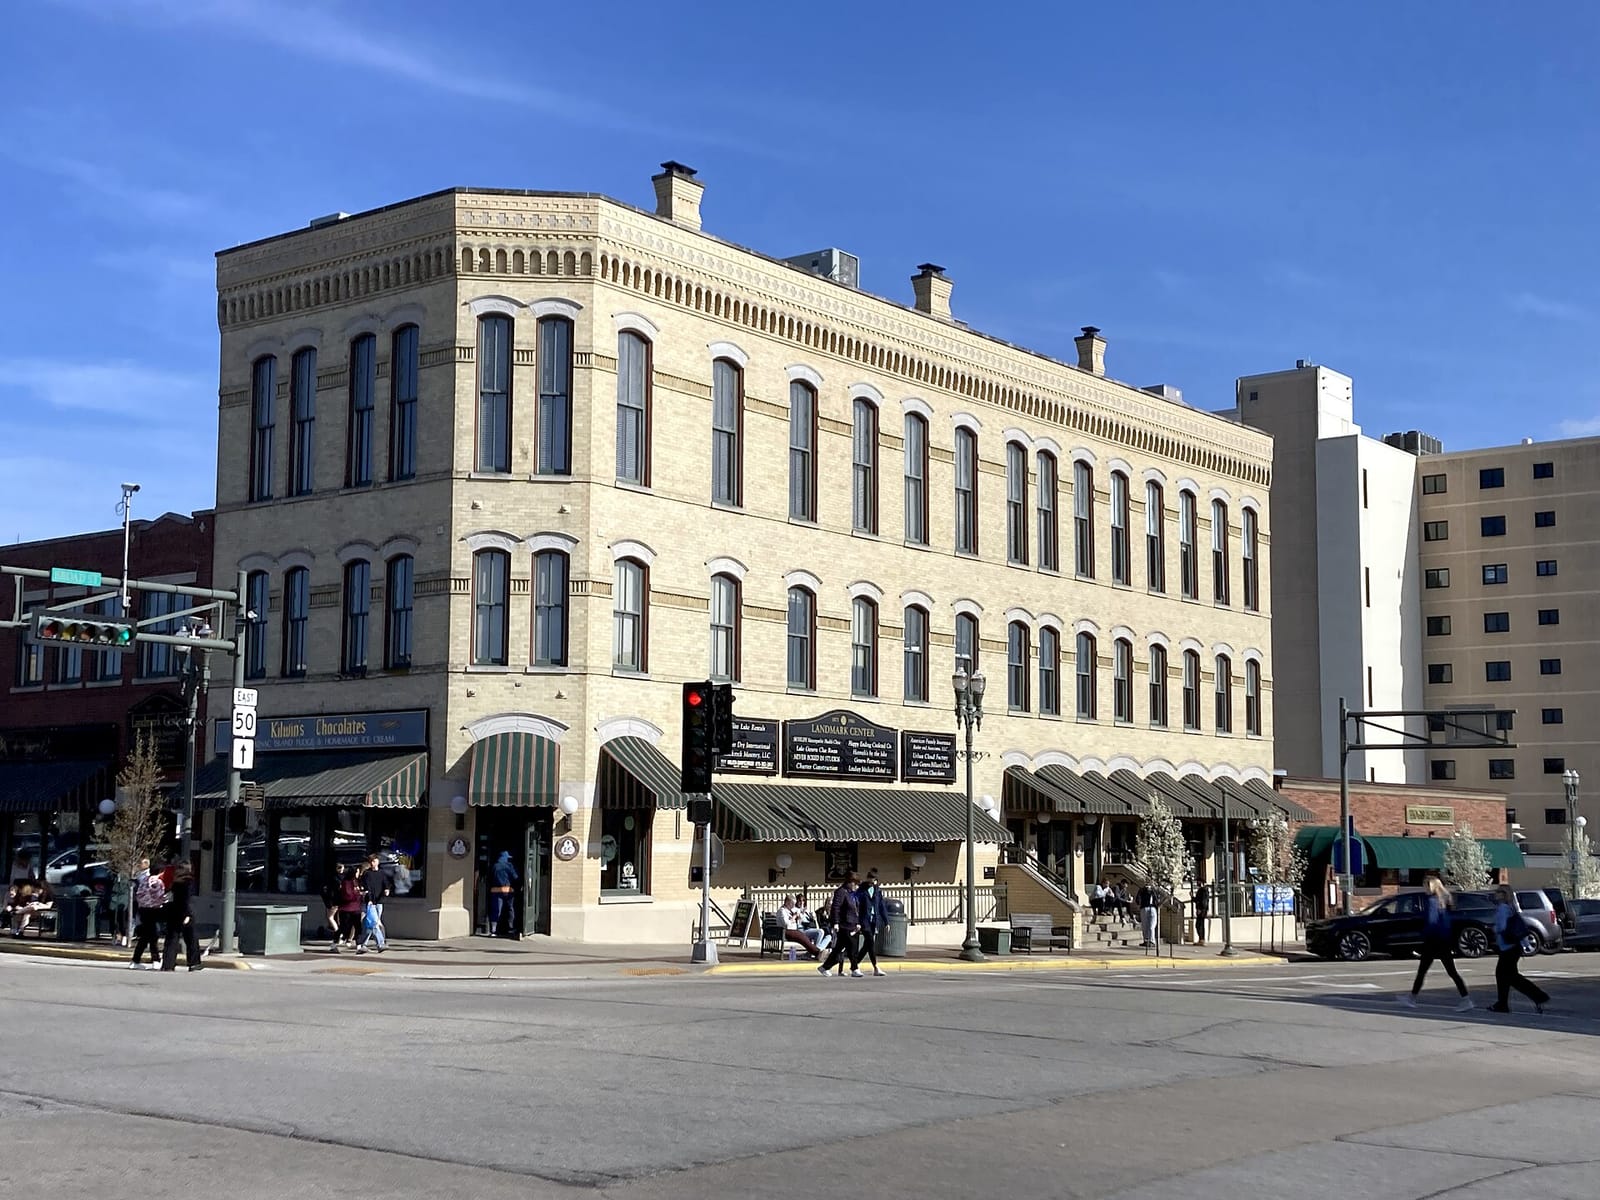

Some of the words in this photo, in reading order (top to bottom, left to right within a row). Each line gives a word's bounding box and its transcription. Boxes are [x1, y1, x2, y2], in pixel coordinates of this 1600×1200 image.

[238, 690, 254, 703] EAST
[236, 712, 254, 730] 50
[271, 721, 304, 738] Kilwin's
[316, 718, 366, 736] Chocolates
[812, 724, 849, 735] LANDMARK
[850, 727, 875, 737] CENTER
[324, 736, 358, 745] HOMEMADE
[373, 735, 394, 744] CREAM
